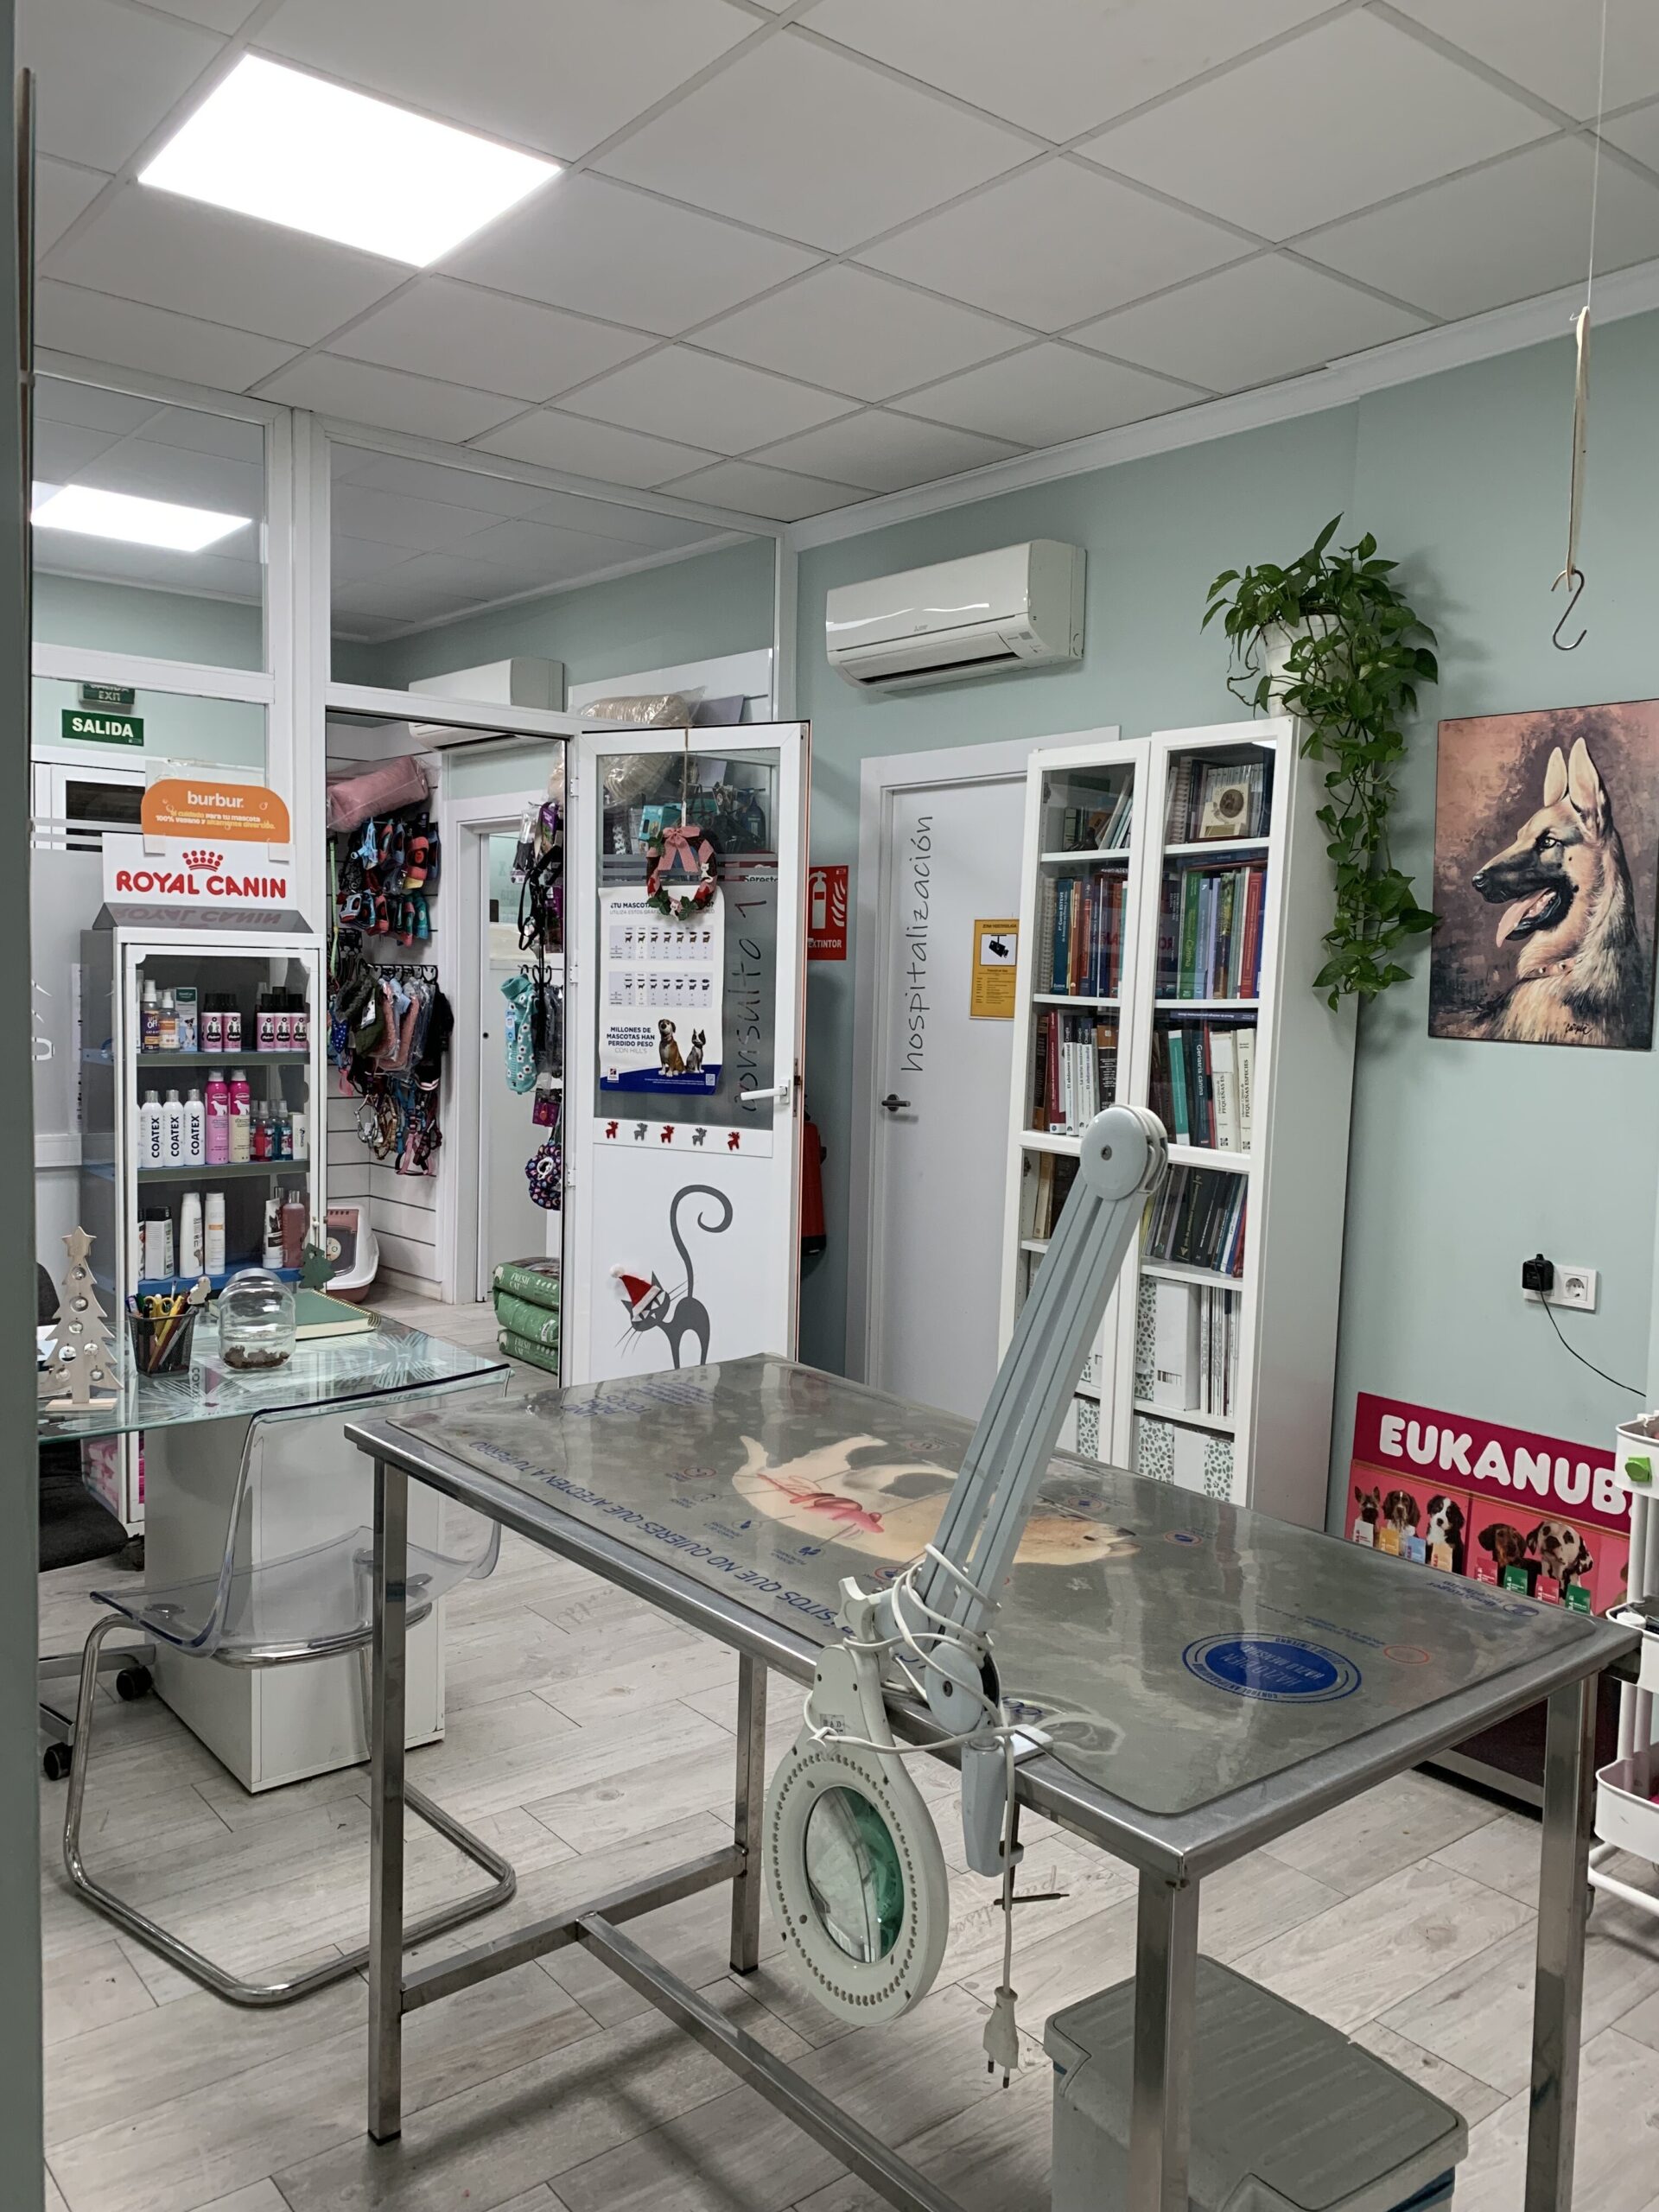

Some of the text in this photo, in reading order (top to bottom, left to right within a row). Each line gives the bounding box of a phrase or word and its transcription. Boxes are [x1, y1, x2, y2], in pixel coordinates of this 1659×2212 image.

[72, 717, 134, 738] SALIDA
[116, 870, 286, 899] ROYAL CANIN
[808, 938, 842, 949] EXTINTOR
[900, 817, 933, 1071] hospitalización
[151, 1116, 160, 1159] COATEX
[170, 1116, 180, 1158] COATEX
[191, 1115, 200, 1156] COATEX
[469, 1441, 517, 1466] PERRO
[514, 1460, 531, 1472] TU
[1379, 1414, 1633, 1519] EUKANUB
[531, 1468, 550, 1477] A
[541, 1475, 613, 1507] AFECTEN
[603, 1505, 644, 1523] QUE
[636, 1522, 712, 1557] QUIERES
[706, 1556, 743, 1573] NO
[734, 1570, 782, 1592] QUE
